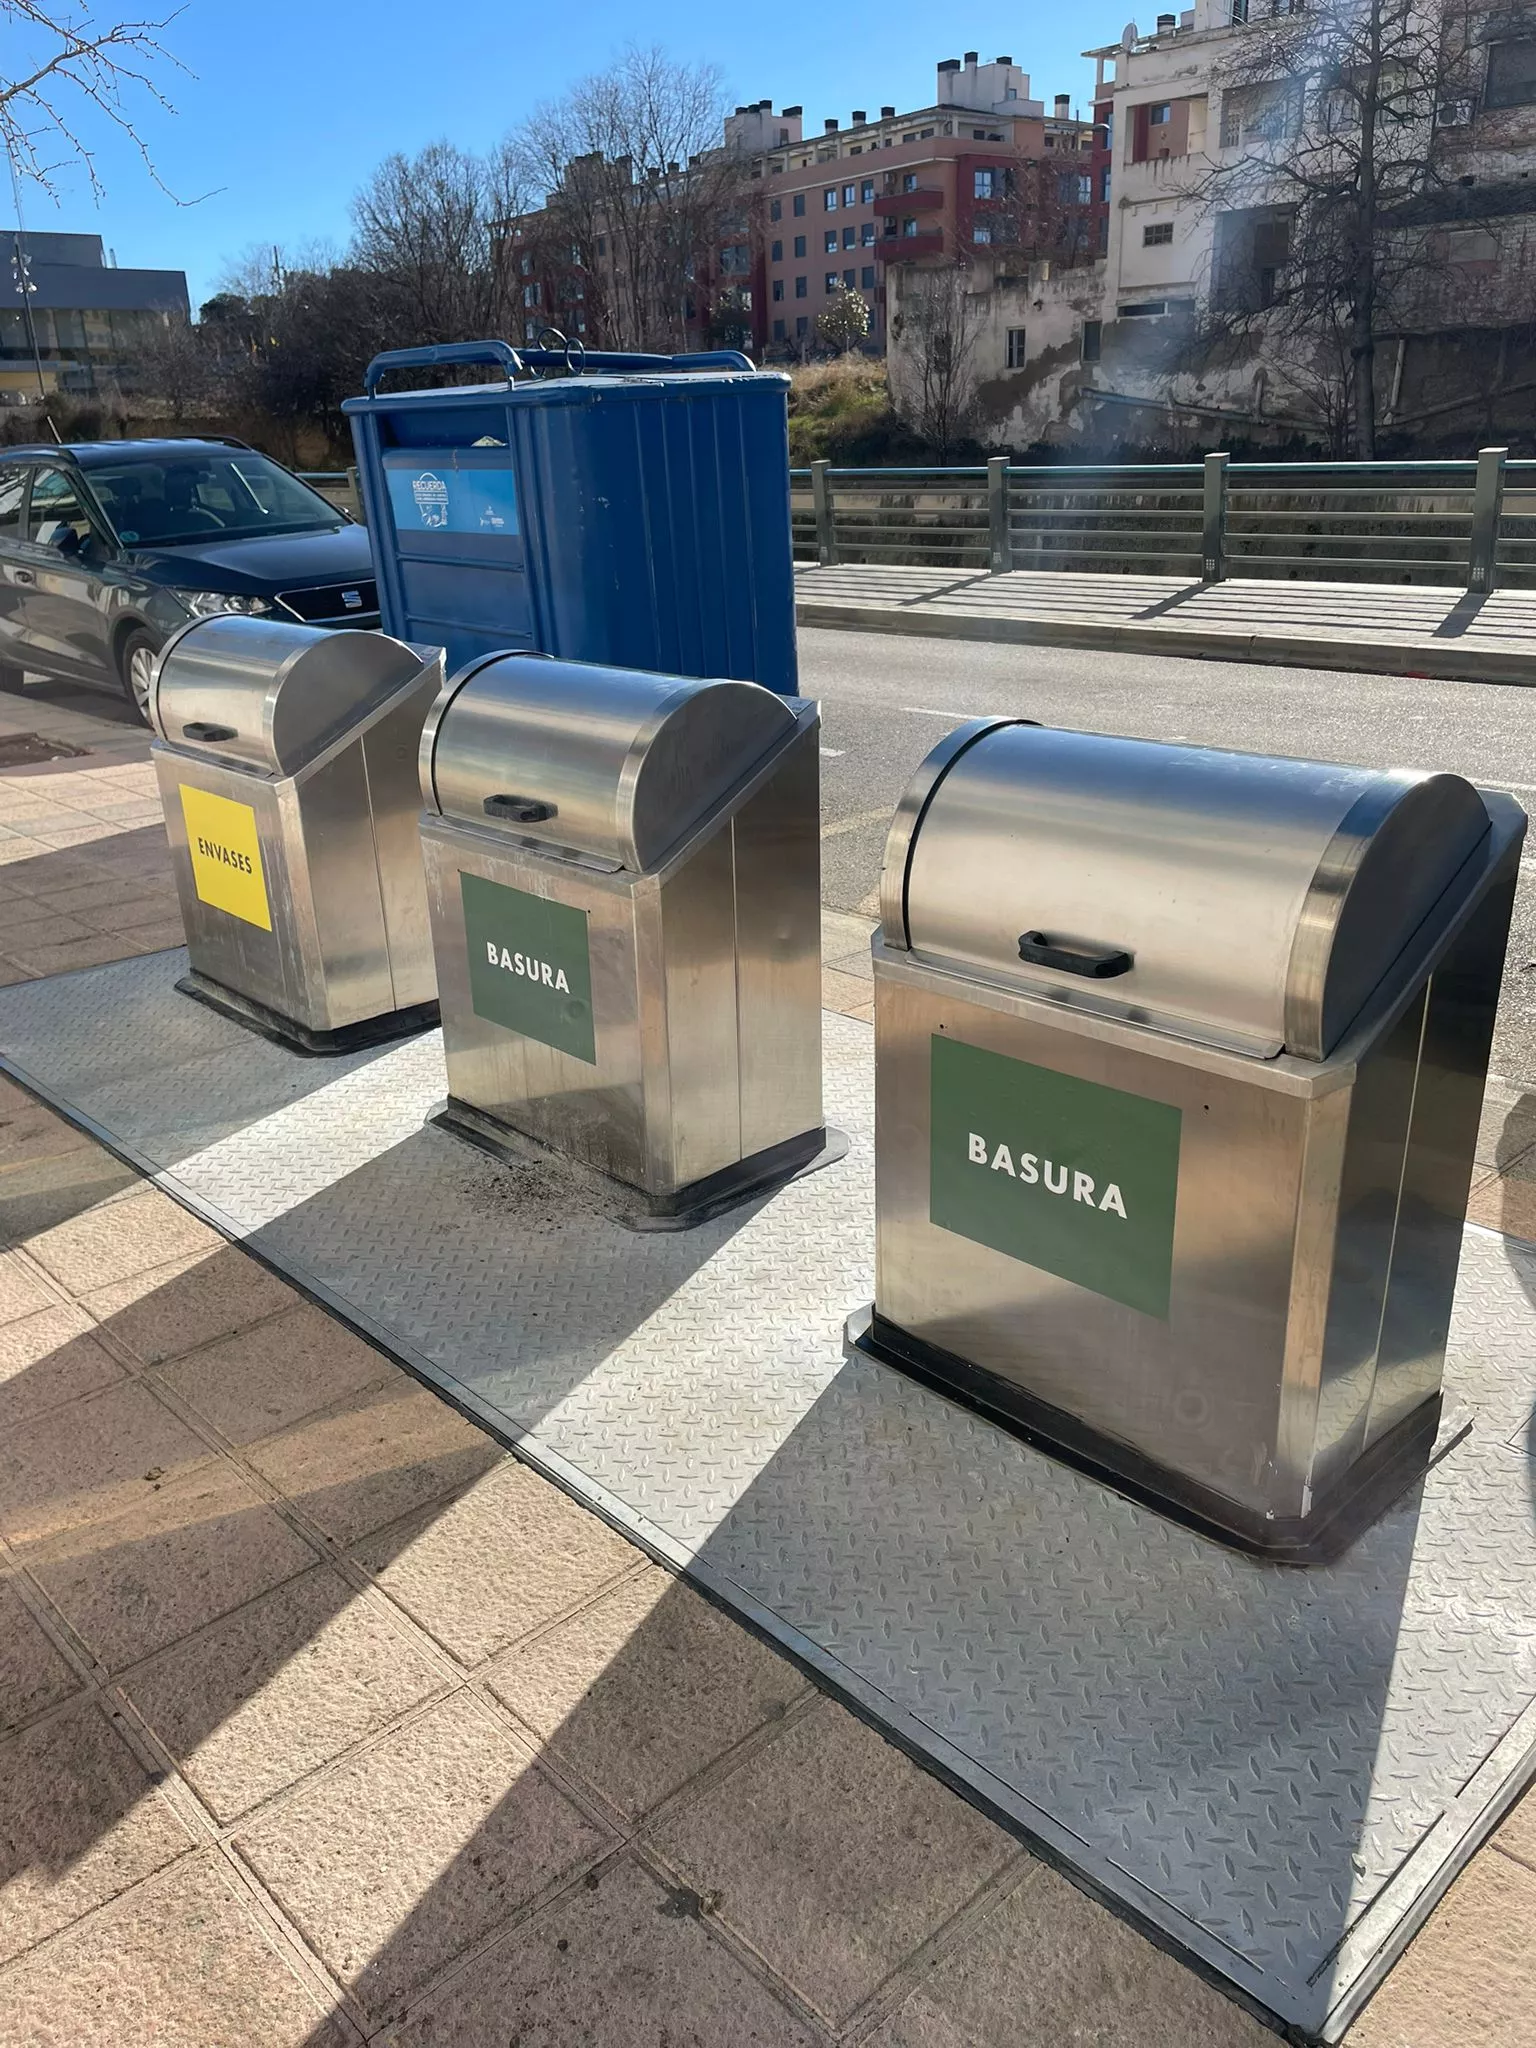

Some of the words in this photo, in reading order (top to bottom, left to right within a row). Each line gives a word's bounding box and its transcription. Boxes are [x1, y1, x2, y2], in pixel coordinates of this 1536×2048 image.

[198, 837, 252, 874] ENVASES
[486, 941, 570, 994] BASURA
[968, 1132, 1128, 1219] BASURA
